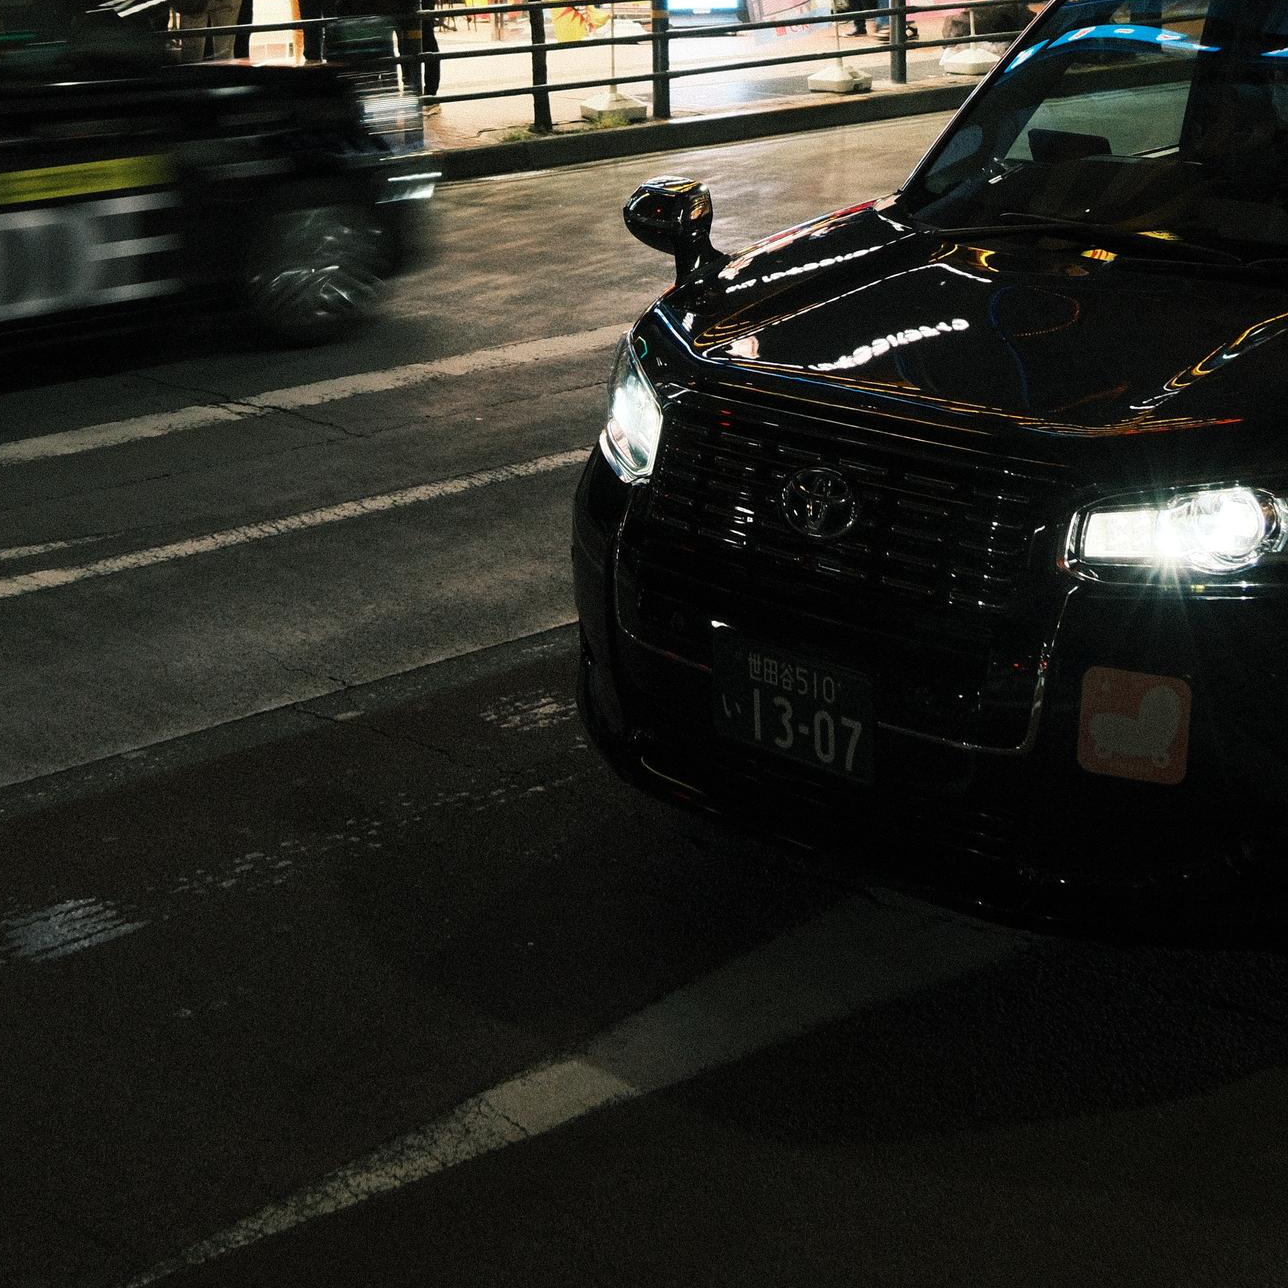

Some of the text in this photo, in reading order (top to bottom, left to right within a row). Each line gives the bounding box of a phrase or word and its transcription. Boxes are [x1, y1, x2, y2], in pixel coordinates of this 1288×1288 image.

[747, 651, 837, 705] 世田谷 510
[720, 687, 863, 773] い 13-07
